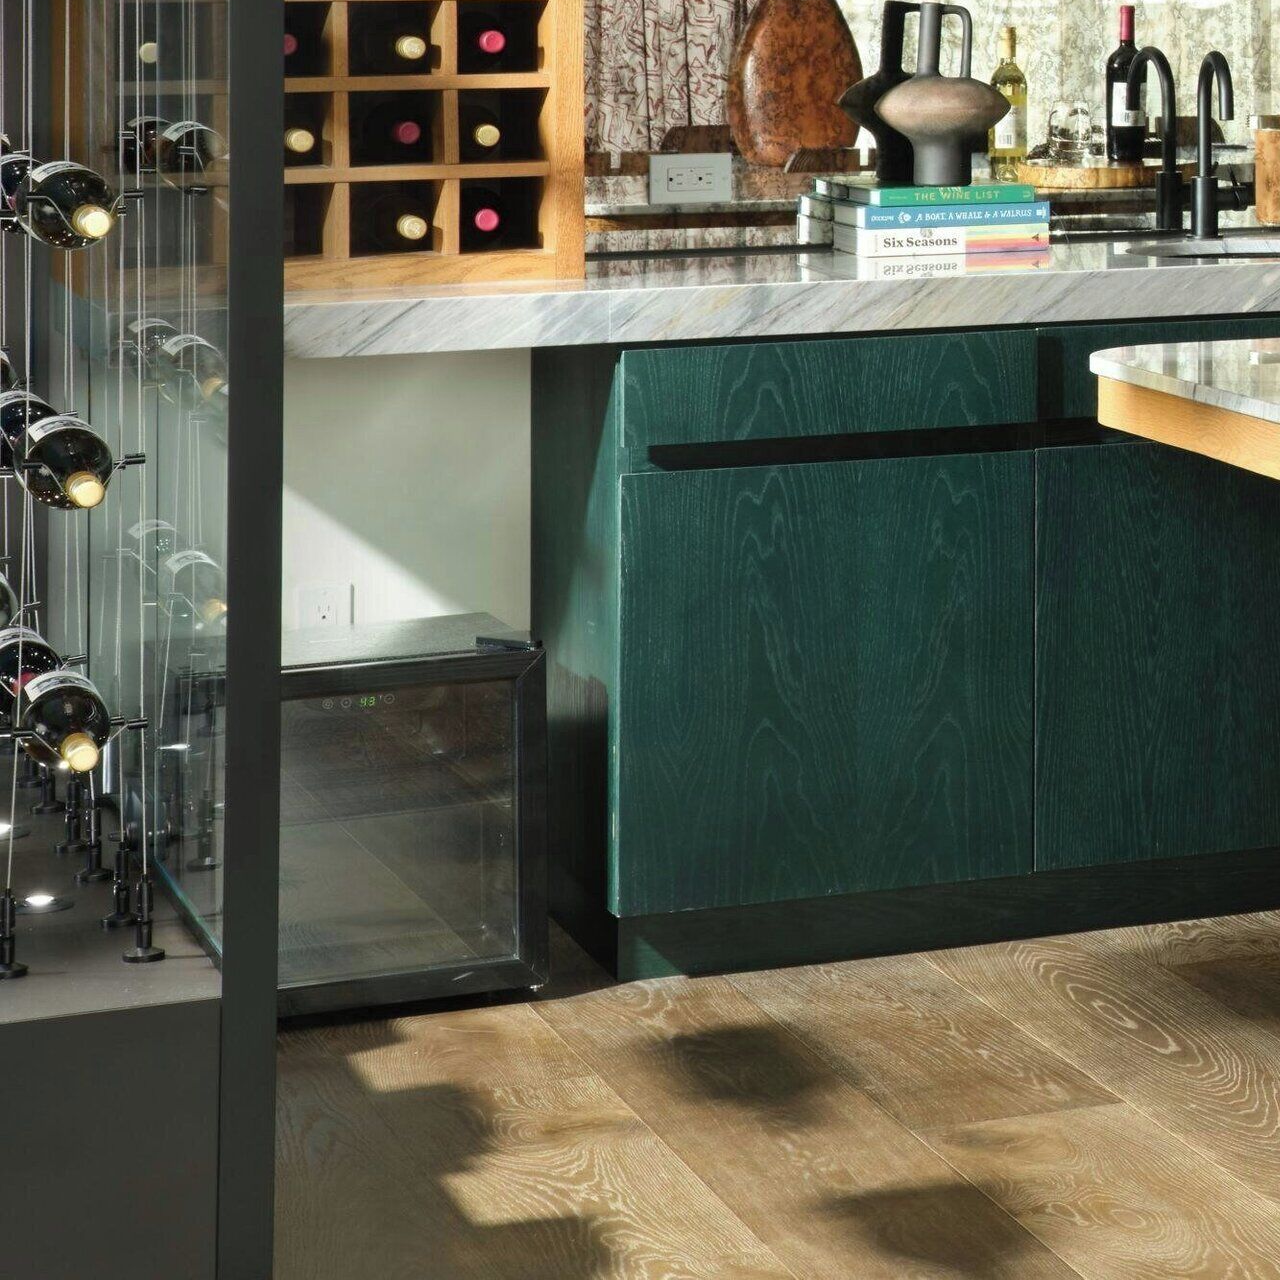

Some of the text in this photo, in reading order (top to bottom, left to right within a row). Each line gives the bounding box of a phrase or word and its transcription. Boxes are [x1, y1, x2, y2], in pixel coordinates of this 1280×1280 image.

[914, 192, 936, 201] THE
[942, 191, 971, 200] WINE
[975, 190, 1000, 200] LIST
[915, 212, 922, 222] A
[948, 212, 954, 220] A
[955, 211, 983, 220] WHALE
[992, 210, 998, 218] A
[999, 208, 1032, 218] WALRUS
[883, 237, 958, 248] Six Seasons
